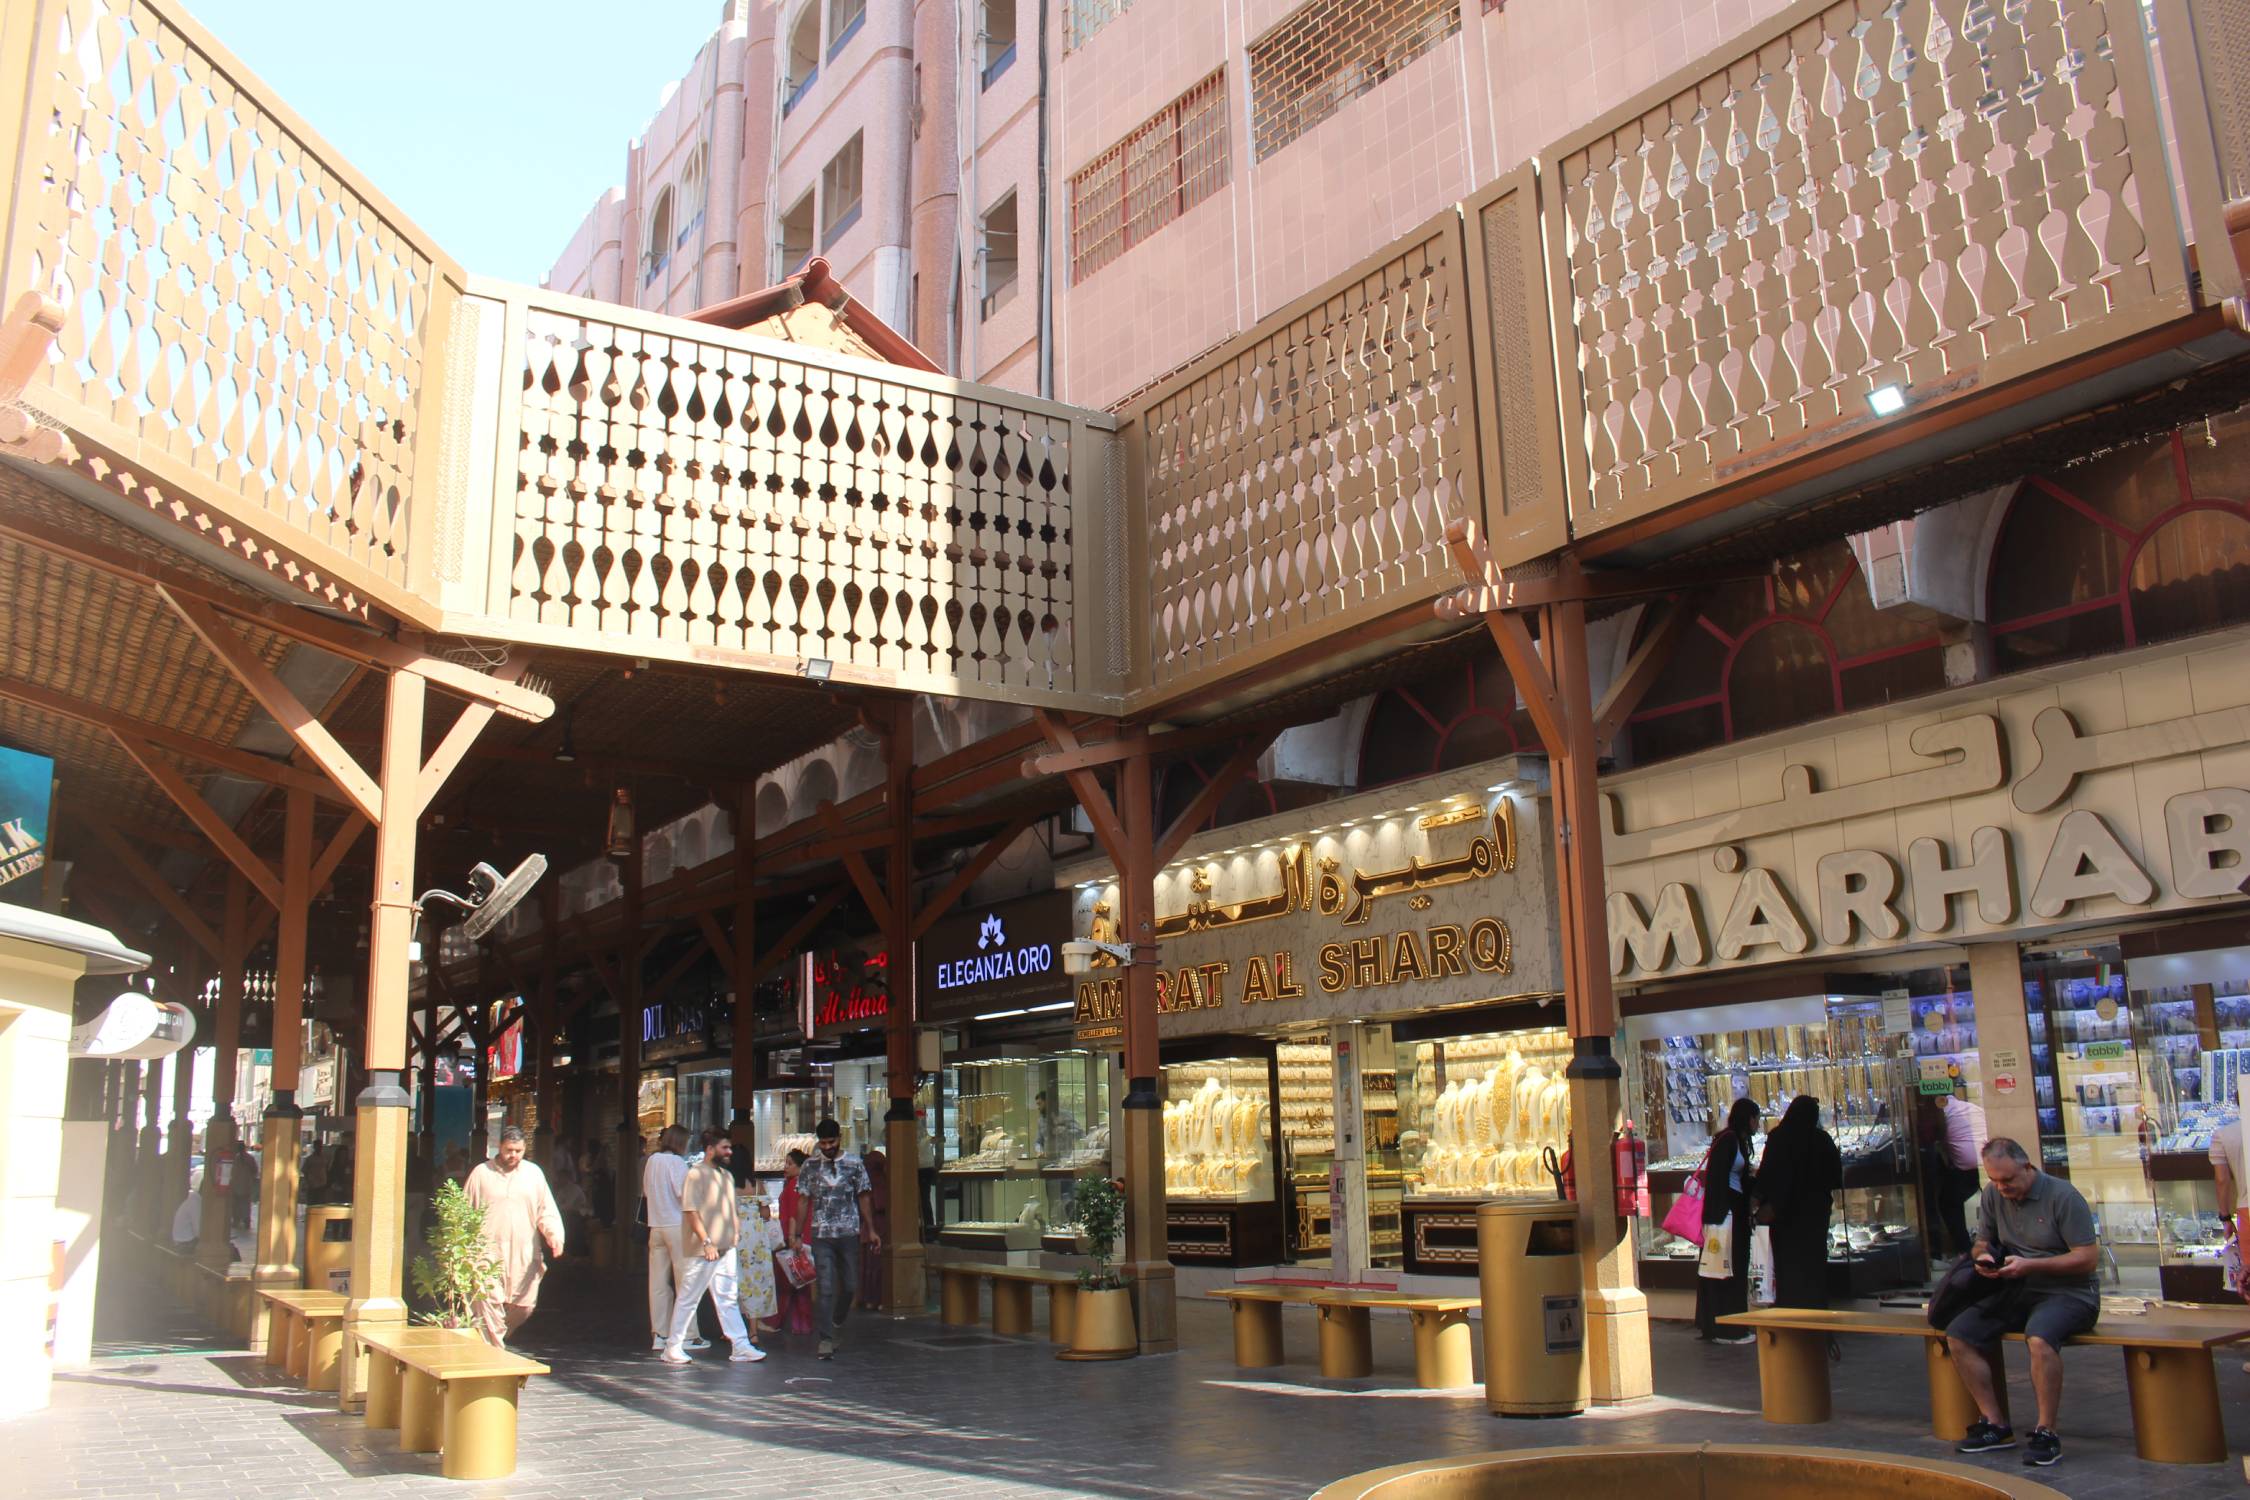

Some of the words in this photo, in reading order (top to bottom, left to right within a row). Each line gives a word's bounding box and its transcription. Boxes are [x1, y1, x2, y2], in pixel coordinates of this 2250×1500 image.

[938, 951, 1015, 989] ELEGANZA
[1017, 943, 1051, 975] ORO
[1241, 951, 1303, 1004] AL
[1318, 917, 1512, 993] SHARQ
[2086, 1045, 2120, 1057] tabby
[1921, 1081, 1951, 1093] tabby
